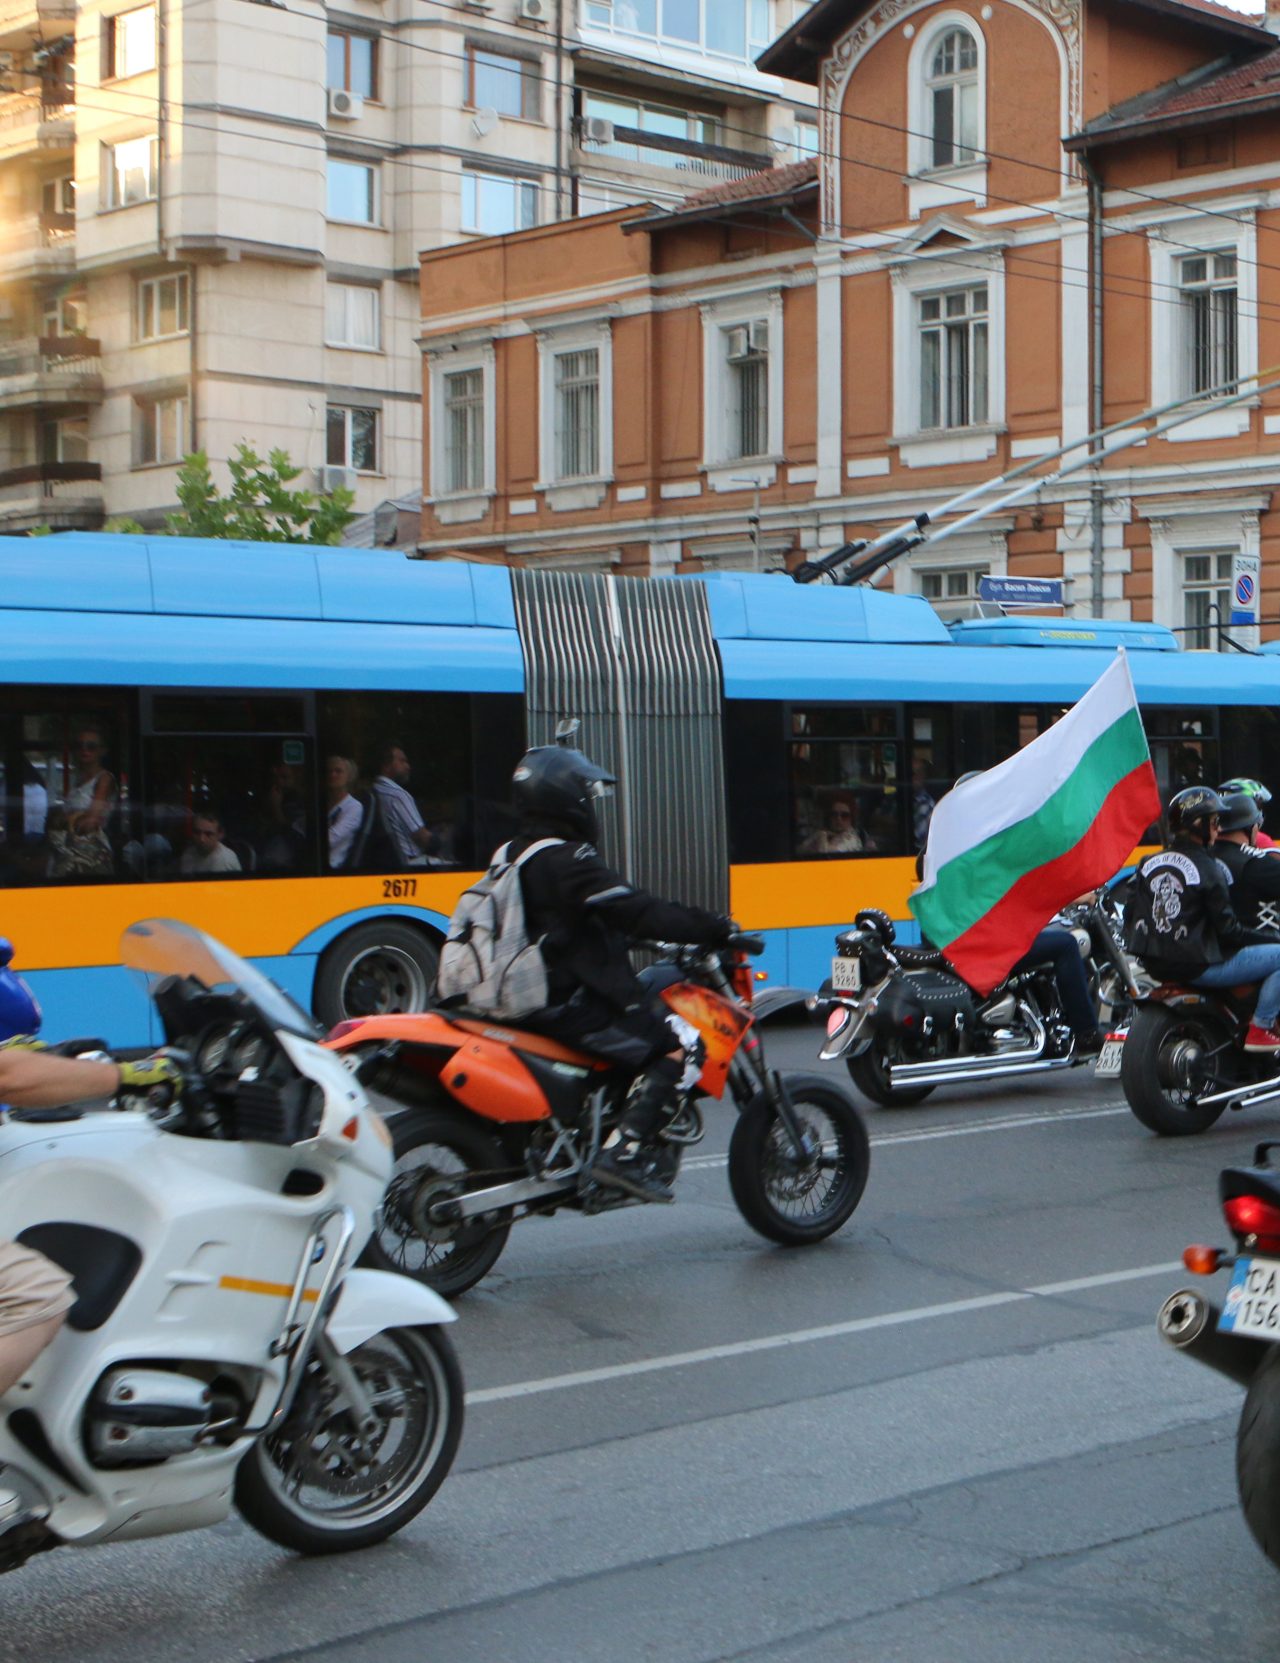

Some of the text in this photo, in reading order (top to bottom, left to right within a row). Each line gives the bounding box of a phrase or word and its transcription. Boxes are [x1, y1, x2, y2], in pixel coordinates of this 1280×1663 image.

[1235, 559, 1257, 572] ЗОНА
[383, 879, 417, 898] 2677
[1247, 1268, 1277, 1297] CA
